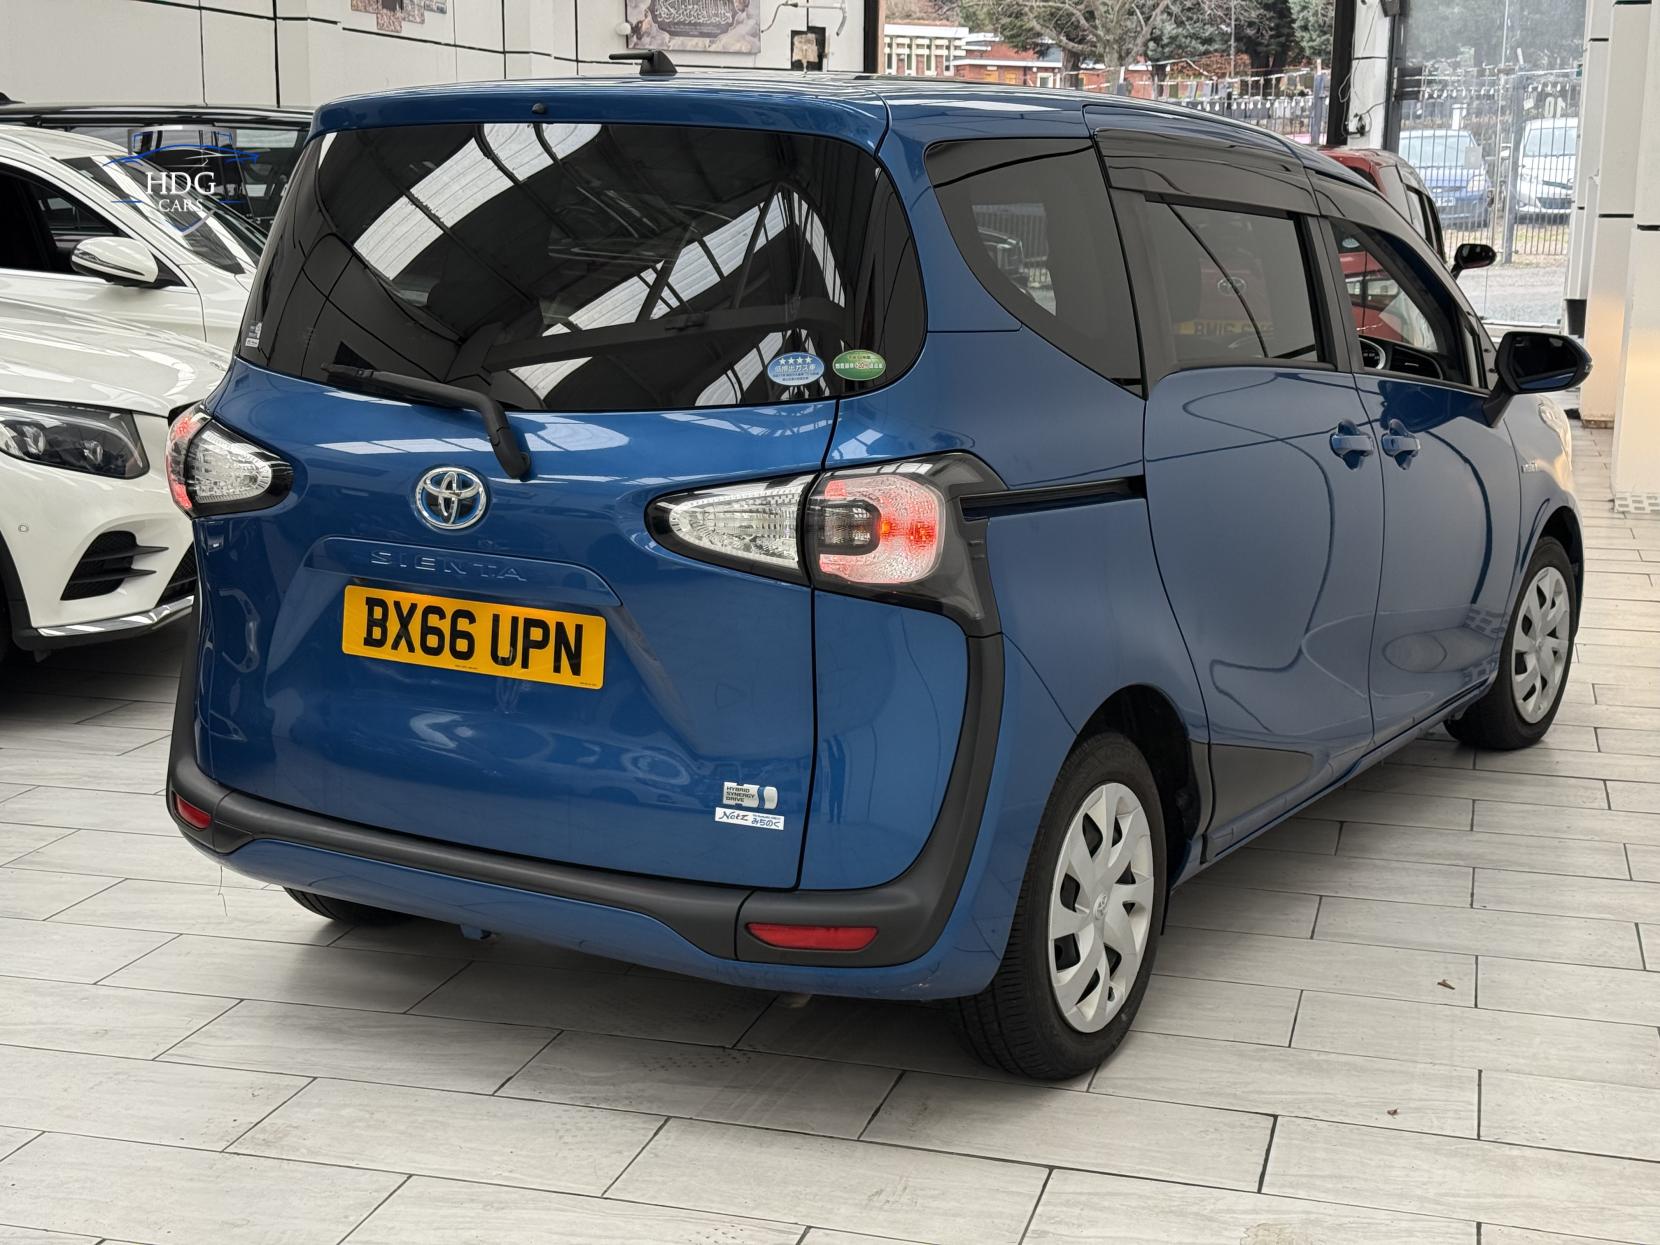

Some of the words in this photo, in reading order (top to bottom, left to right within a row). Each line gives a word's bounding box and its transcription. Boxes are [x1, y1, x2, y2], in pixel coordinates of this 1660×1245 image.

[370, 550, 527, 582] SIENTA
[363, 596, 477, 661] BX66
[490, 613, 584, 677] UPN
[726, 791, 755, 799] SYNERGY
